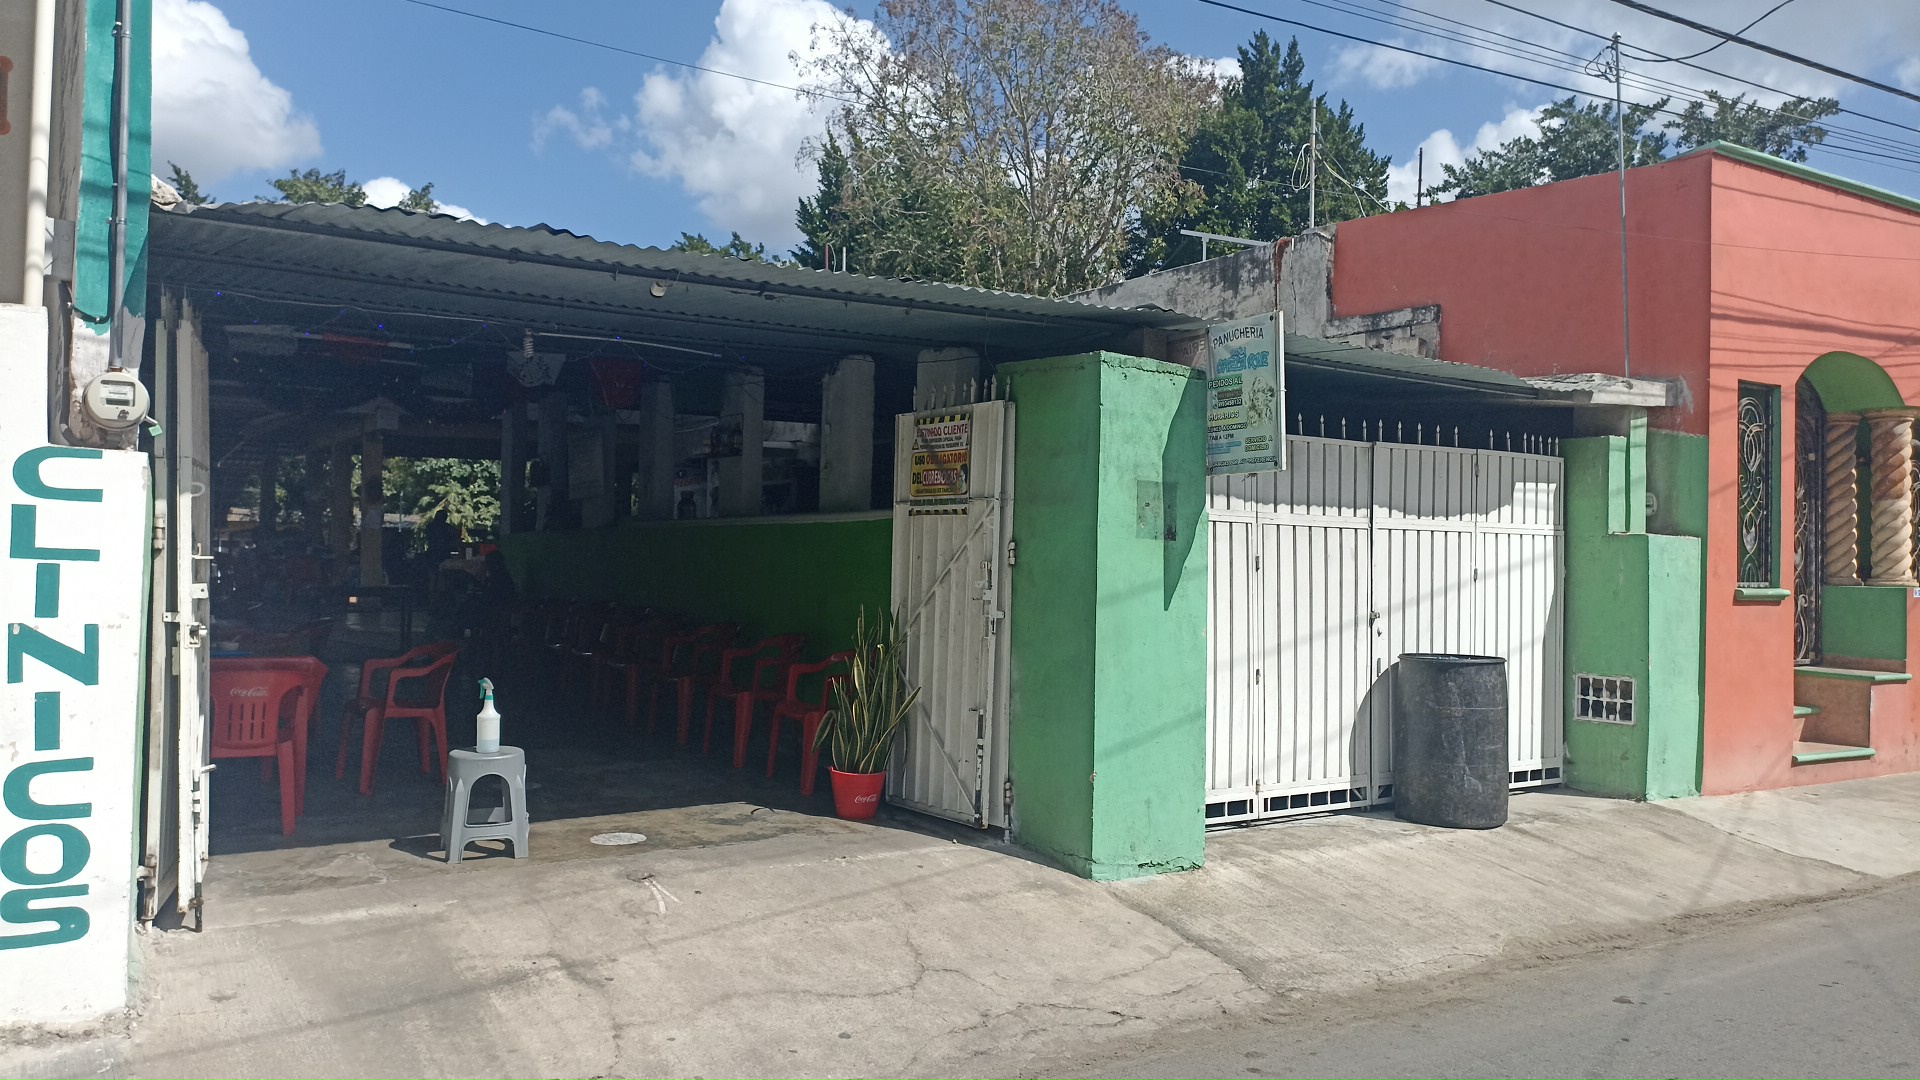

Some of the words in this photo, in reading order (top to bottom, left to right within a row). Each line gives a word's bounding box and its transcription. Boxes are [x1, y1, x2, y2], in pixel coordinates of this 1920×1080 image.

[1213, 327, 1264, 349] PANUCHERIA
[1208, 378, 1233, 389] PEDIDOS
[1208, 411, 1239, 421] HORARIOS
[943, 424, 967, 435] CLIENTE
[1227, 422, 1247, 431] DOMINGO
[1245, 435, 1267, 444] SERVICIO
[1245, 443, 1269, 452] DOMICILIO
[915, 455, 925, 465] USO
[912, 472, 923, 484] DEL
[0, 445, 103, 950] CLINICOS
